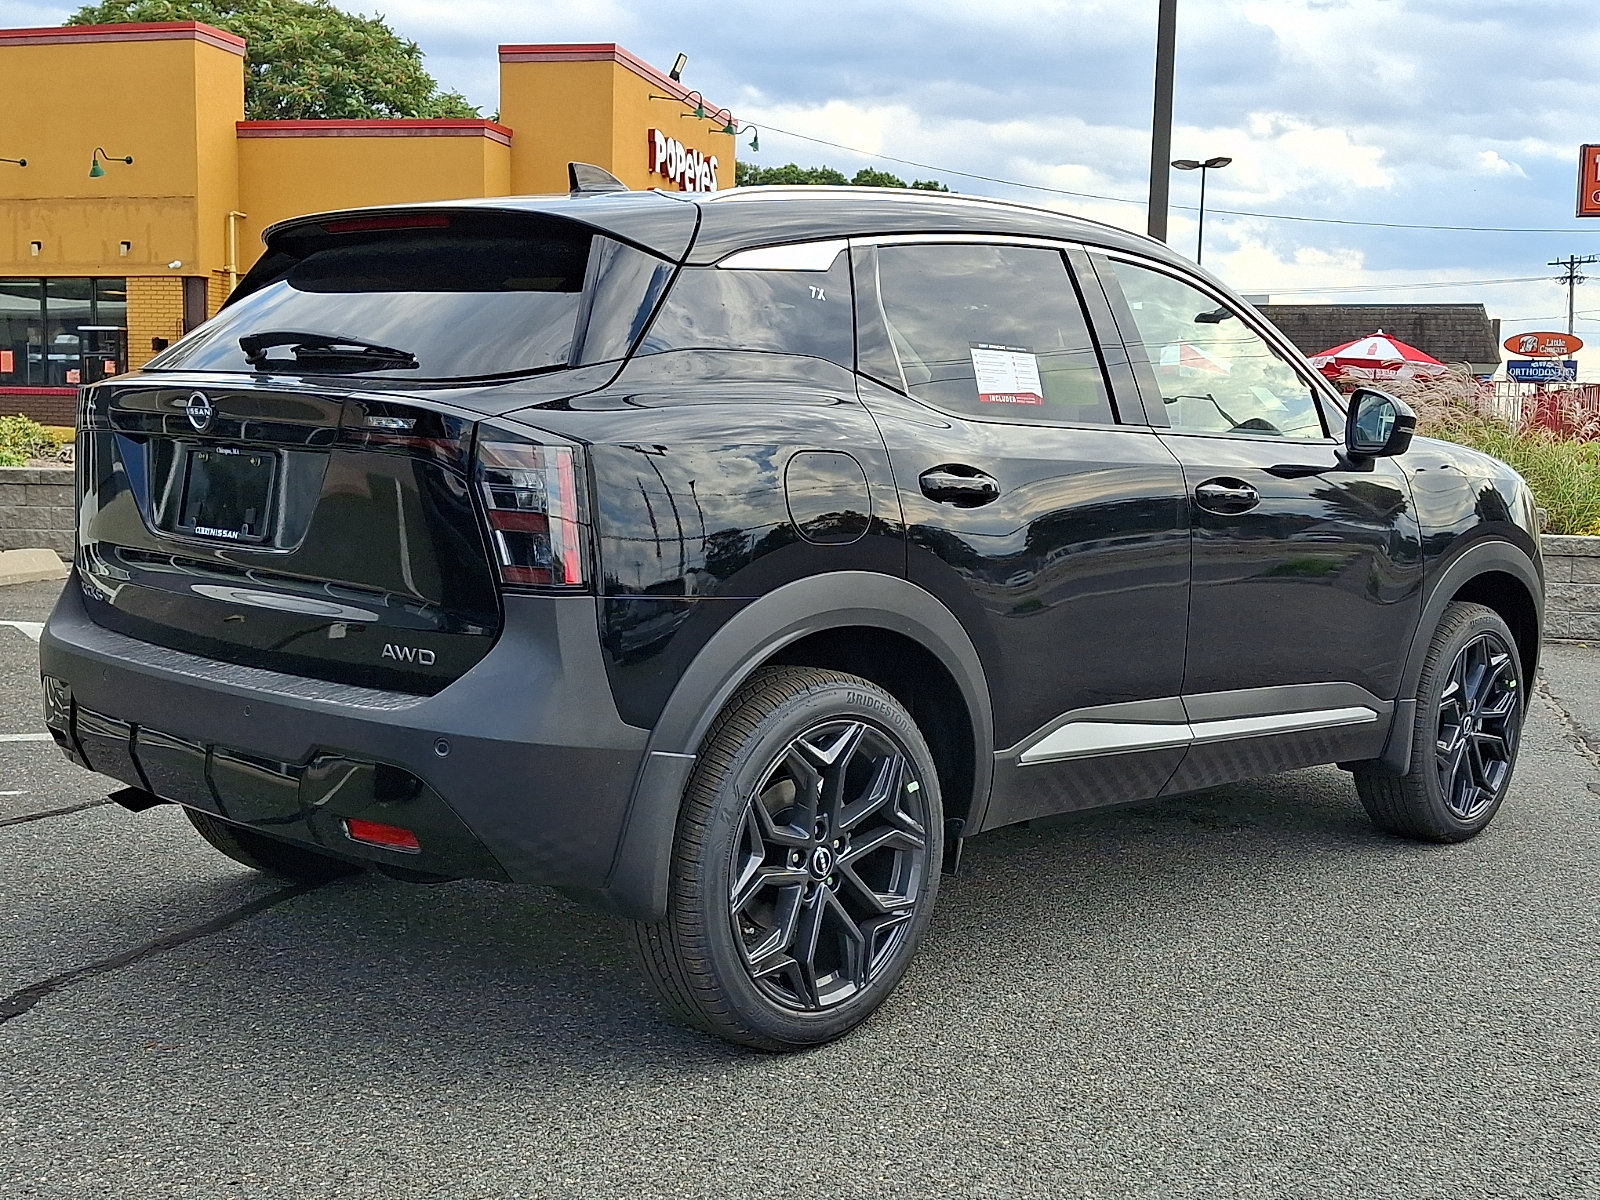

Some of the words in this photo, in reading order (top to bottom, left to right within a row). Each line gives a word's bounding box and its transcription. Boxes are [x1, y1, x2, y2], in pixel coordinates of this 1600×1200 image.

[1545, 339, 1566, 347] Little
[381, 643, 436, 666] AWD
[846, 691, 913, 736] BRIDGESTONE
